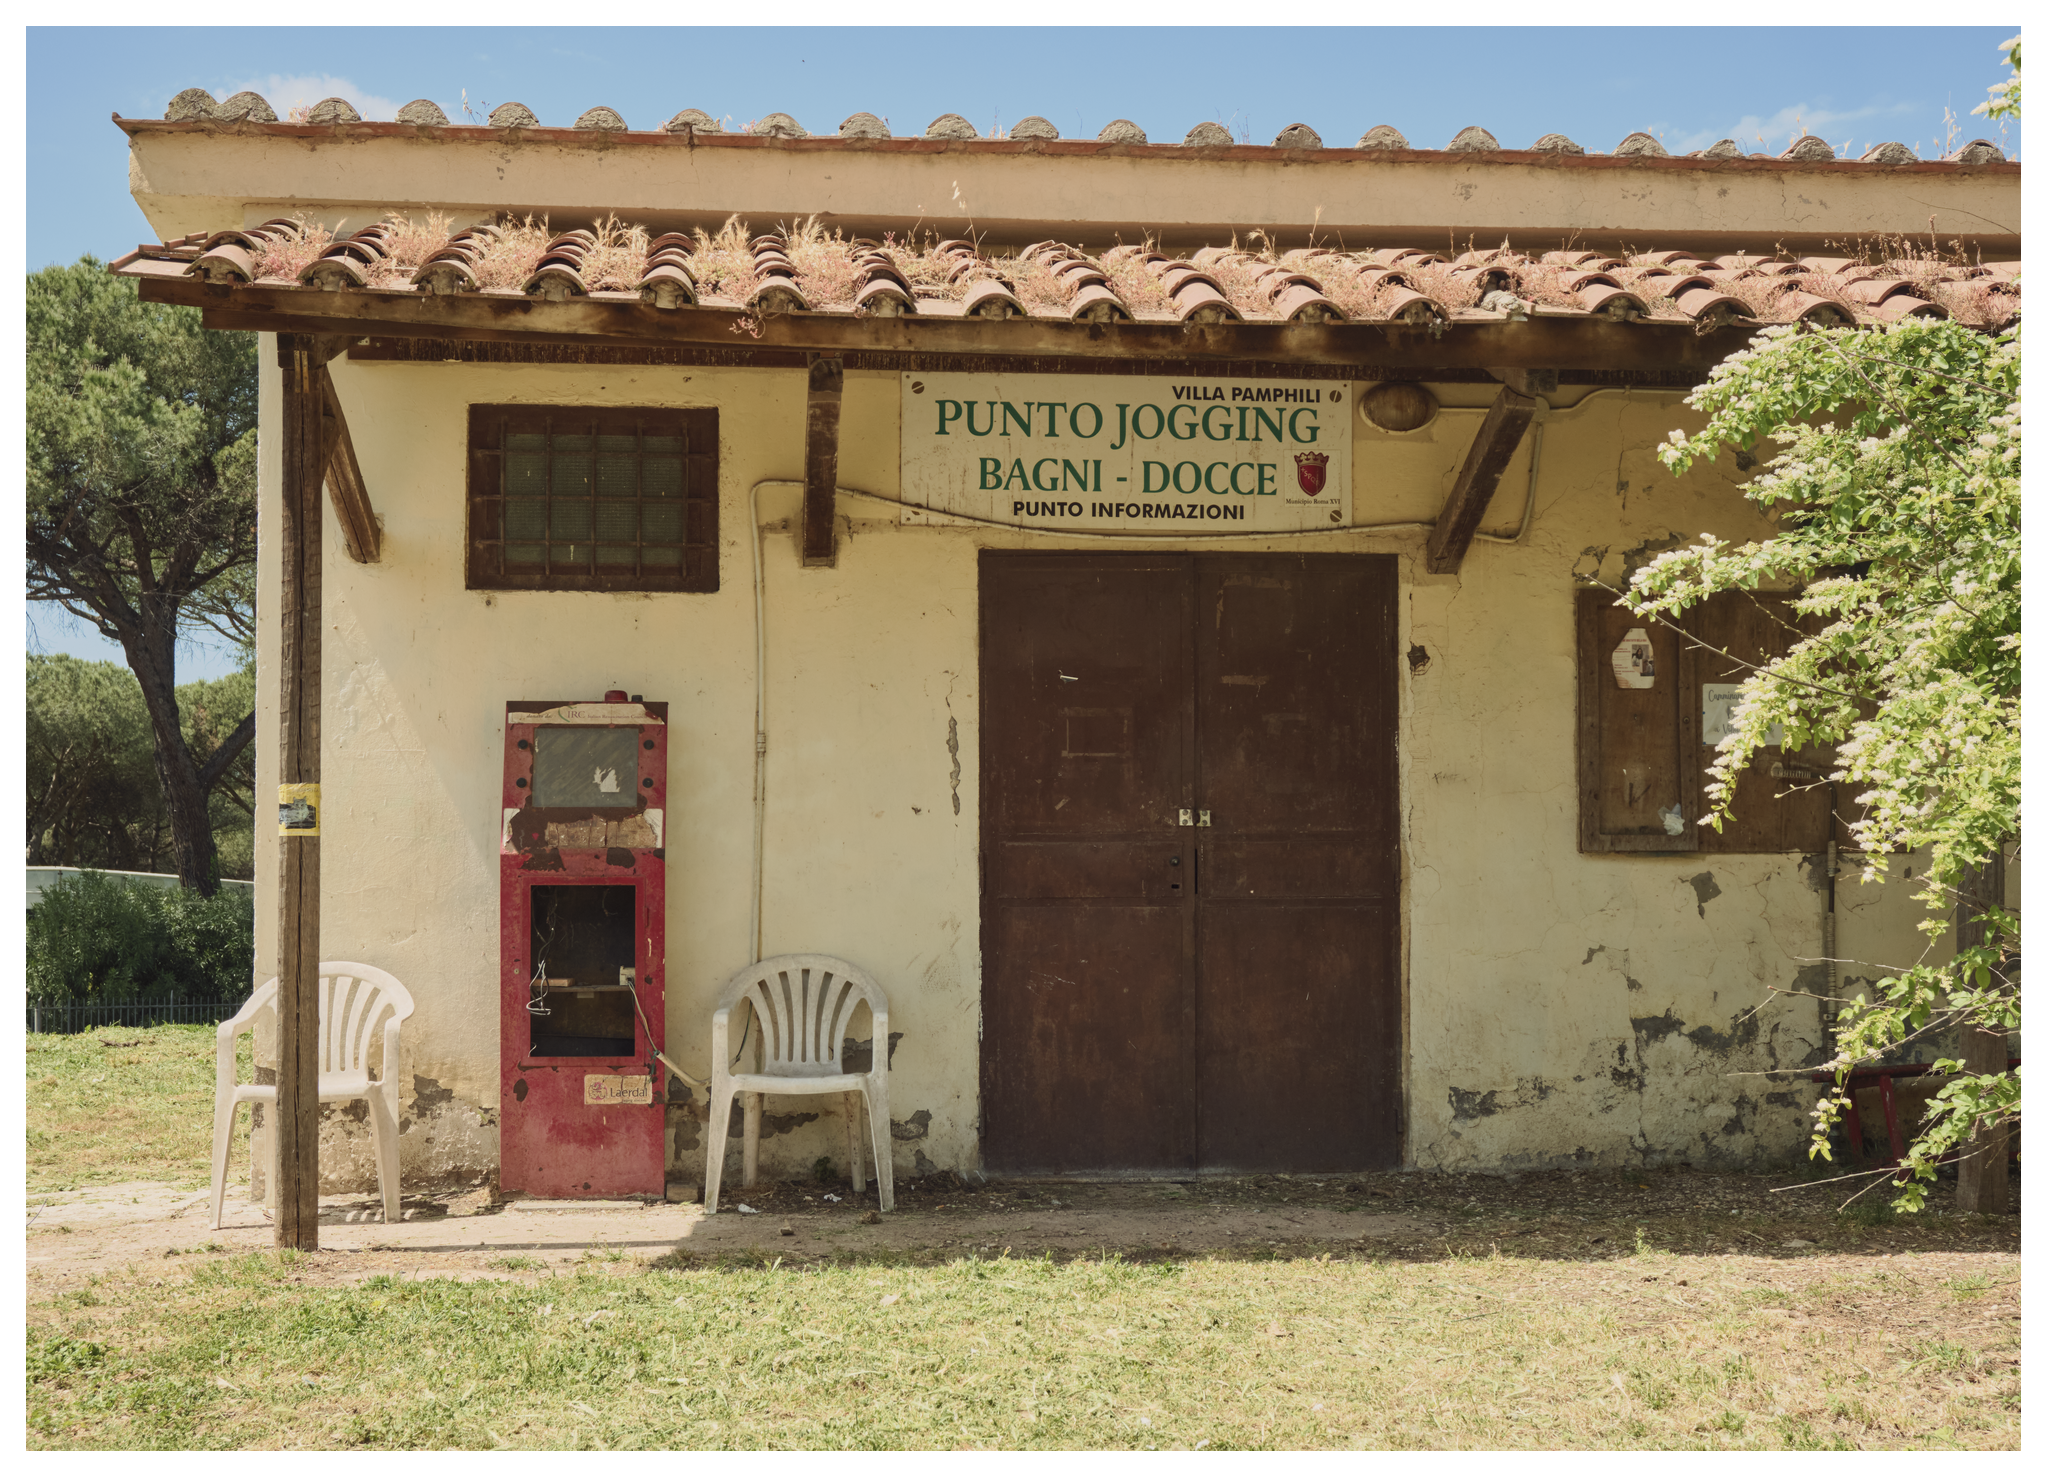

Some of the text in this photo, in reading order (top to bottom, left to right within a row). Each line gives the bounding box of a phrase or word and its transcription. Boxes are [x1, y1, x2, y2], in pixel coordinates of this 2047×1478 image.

[1172, 386, 1321, 403] VILLA PAMPHILI
[935, 399, 1321, 450] PUNTO JOGGING
[979, 457, 1102, 492] BAGNI
[1142, 461, 1277, 495] DOCCE
[1013, 501, 1245, 519] PUNTO INFORMAZIONI
[1286, 498, 1312, 506] Municipio
[567, 710, 586, 719] IRC
[610, 1088, 648, 1098] Laerdal
